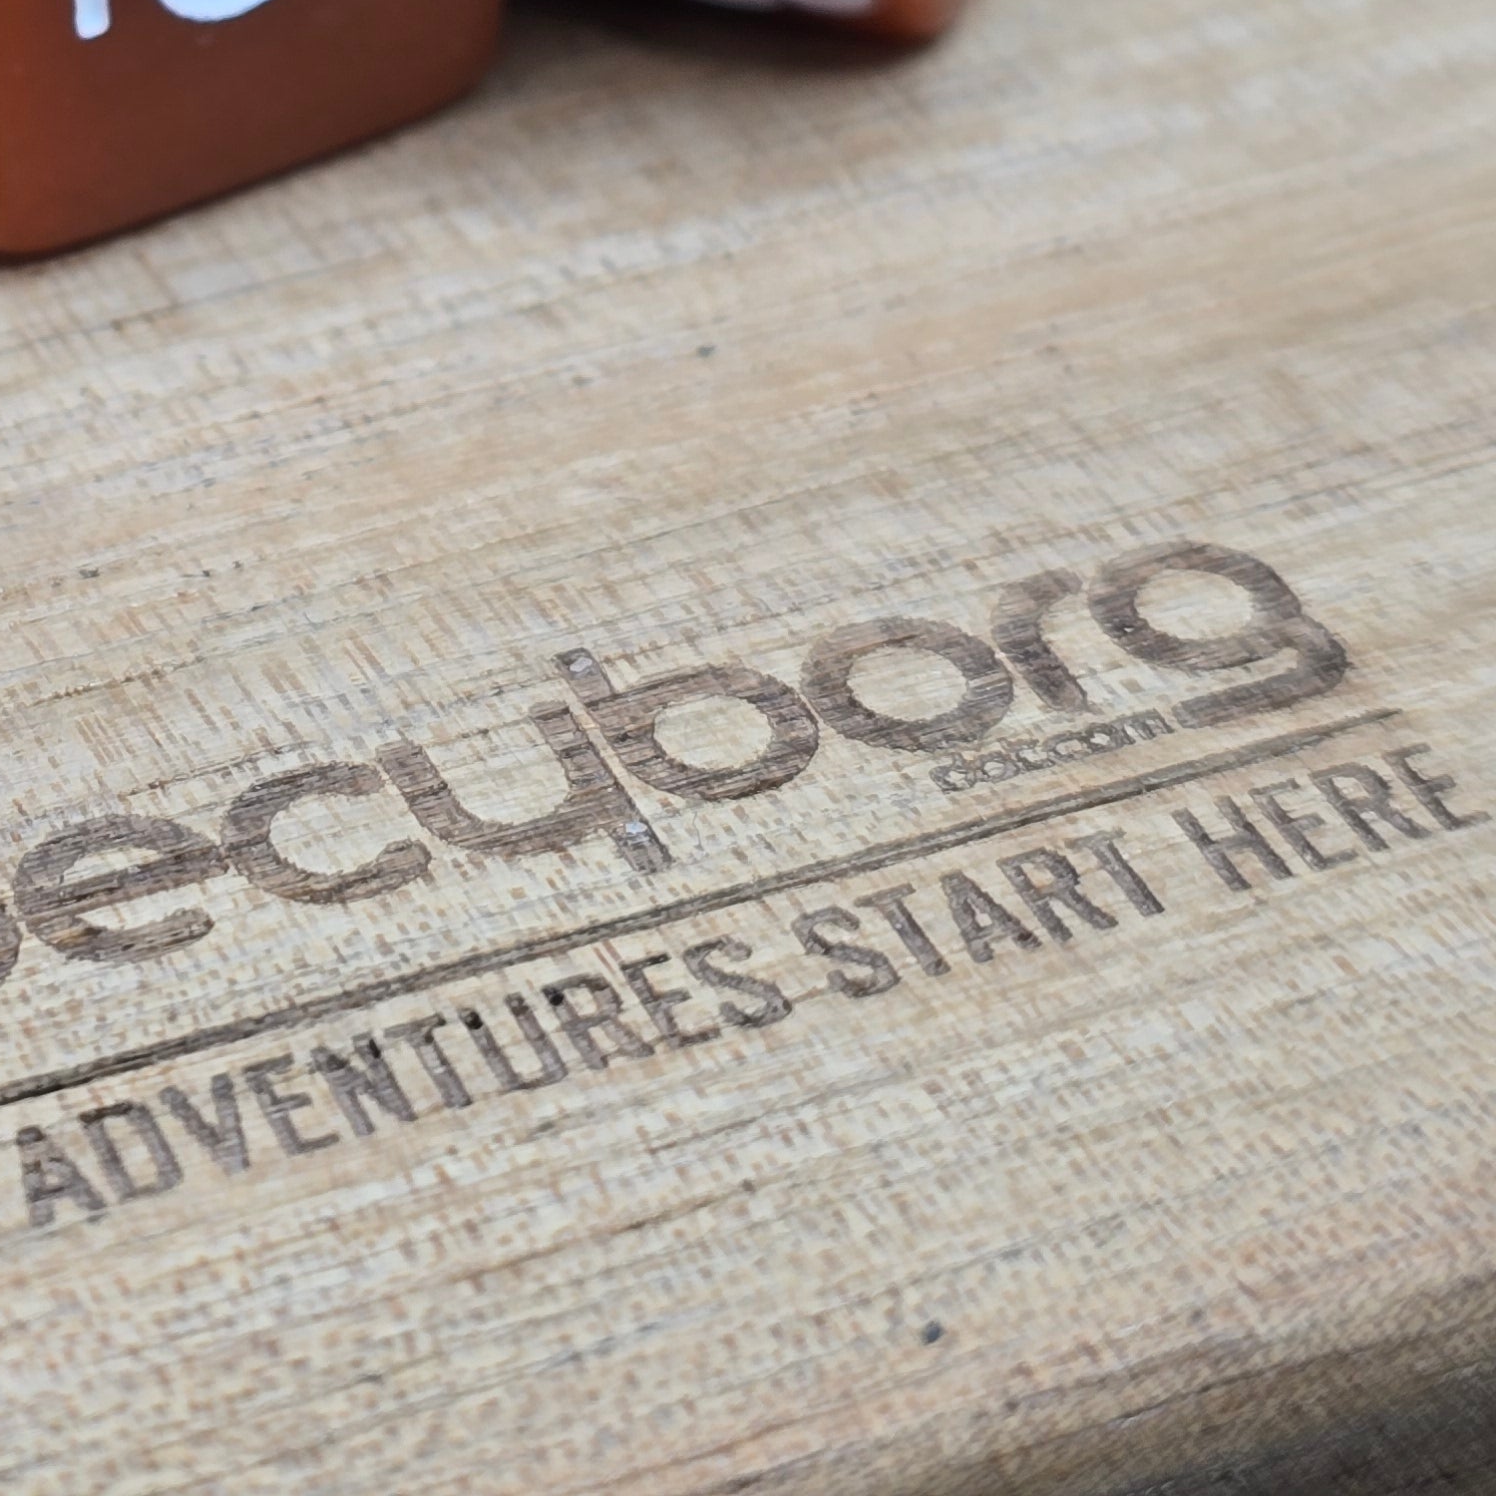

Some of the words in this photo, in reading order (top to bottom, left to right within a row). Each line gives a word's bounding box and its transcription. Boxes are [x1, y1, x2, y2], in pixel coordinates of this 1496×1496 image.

[12, 936, 794, 1228] ADVENTURES
[790, 830, 1166, 1000] START
[1170, 742, 1492, 894] HERE
